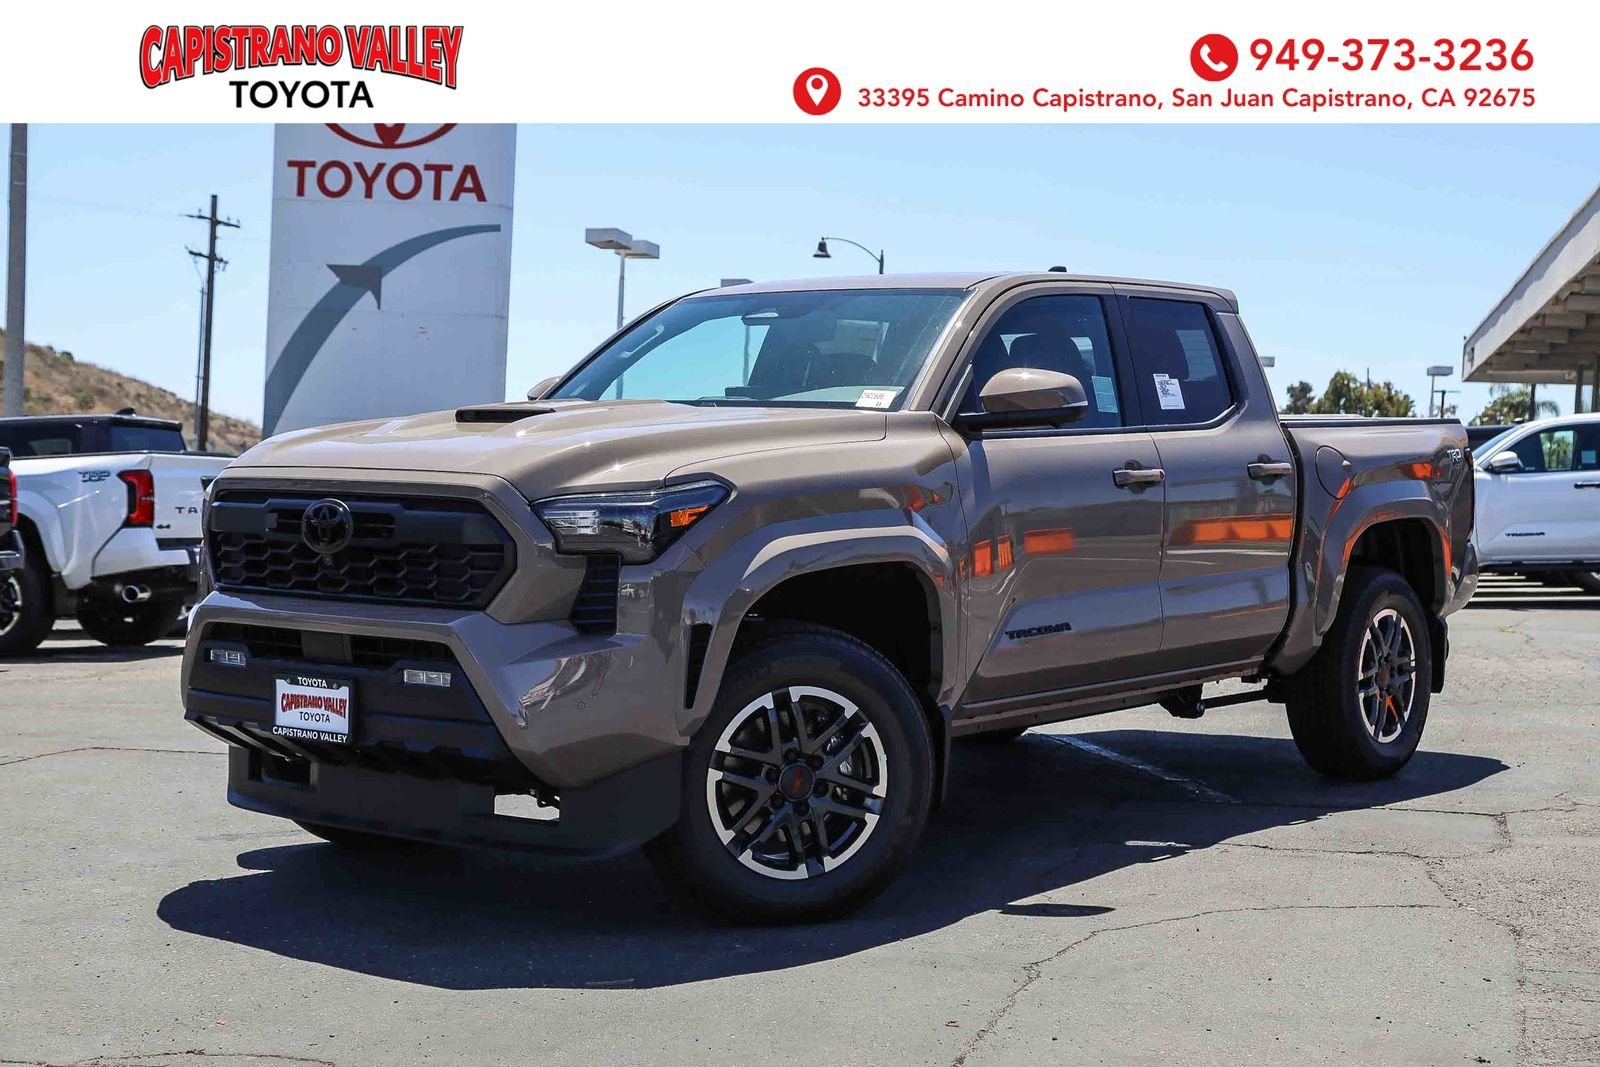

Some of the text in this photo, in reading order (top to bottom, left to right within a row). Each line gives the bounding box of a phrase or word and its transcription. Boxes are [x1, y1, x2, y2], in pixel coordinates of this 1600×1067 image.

[287, 160, 487, 203] TOYOTA
[297, 676, 328, 689] TOYOTA
[281, 692, 347, 720] CAPISTRANO VALLEY
[299, 711, 331, 724] TOYOTA
[272, 726, 347, 744] CAPISTRANO VALLEY
